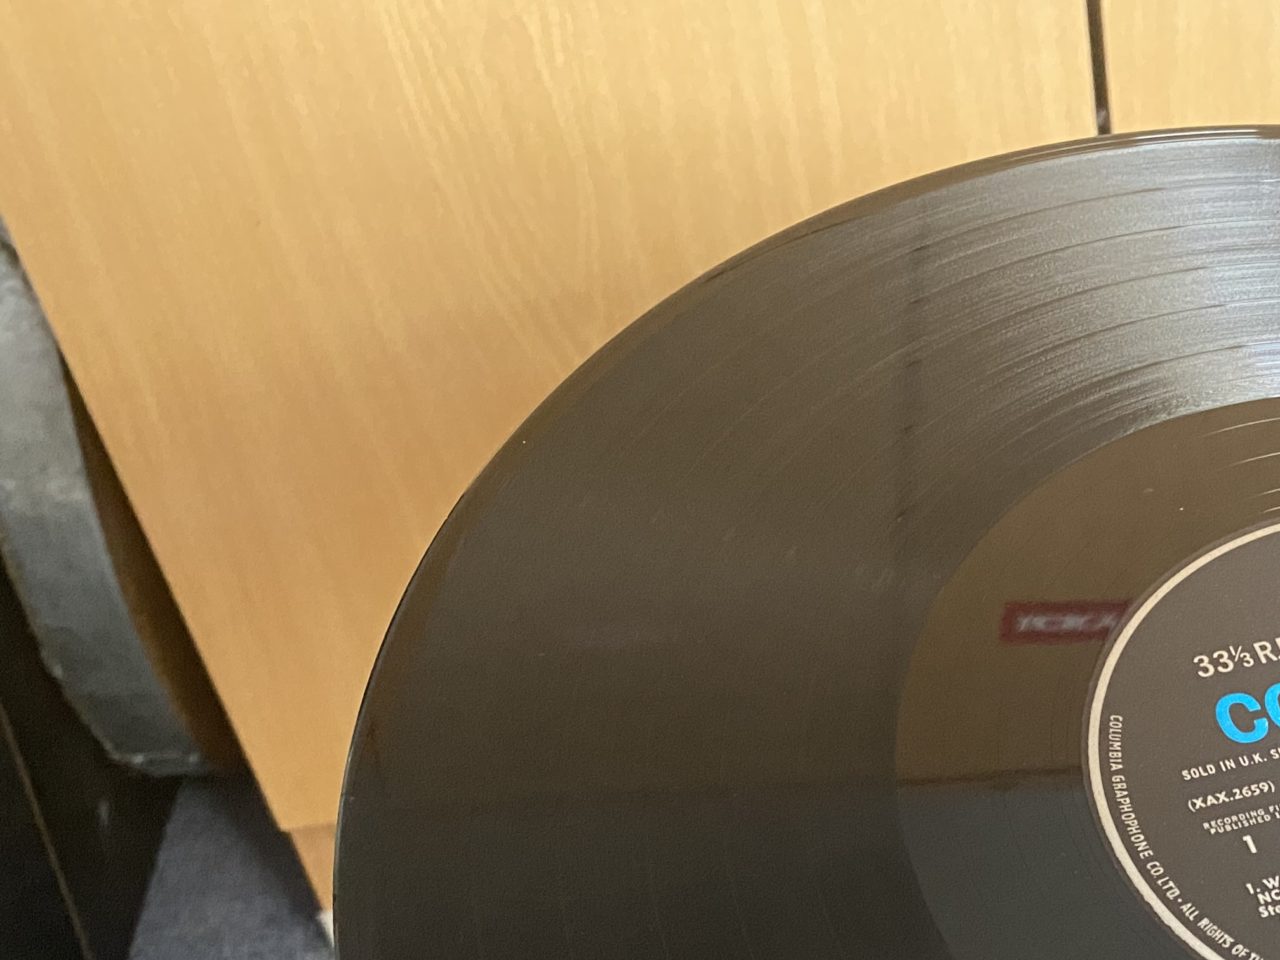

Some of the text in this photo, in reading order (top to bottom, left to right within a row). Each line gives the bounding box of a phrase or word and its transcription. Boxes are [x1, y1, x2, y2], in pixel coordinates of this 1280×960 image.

[1108, 714, 1123, 772] COLUMBIA
[1181, 763, 1216, 781] SOLD
[1219, 758, 1236, 772] IN
[1239, 752, 1267, 767] U.K.
[1187, 780, 1276, 812] (XAX.2659)
[1112, 774, 1154, 859] GRAPHOPHONE
[1203, 808, 1266, 830] RECORDING
[1209, 814, 1271, 835] PUBLISHED
[1242, 834, 1257, 854] 1
[1245, 882, 1261, 895] 1.
[1179, 902, 1199, 921] ALL
[1197, 917, 1234, 948] RIGHTS
[1231, 943, 1249, 958] OF
